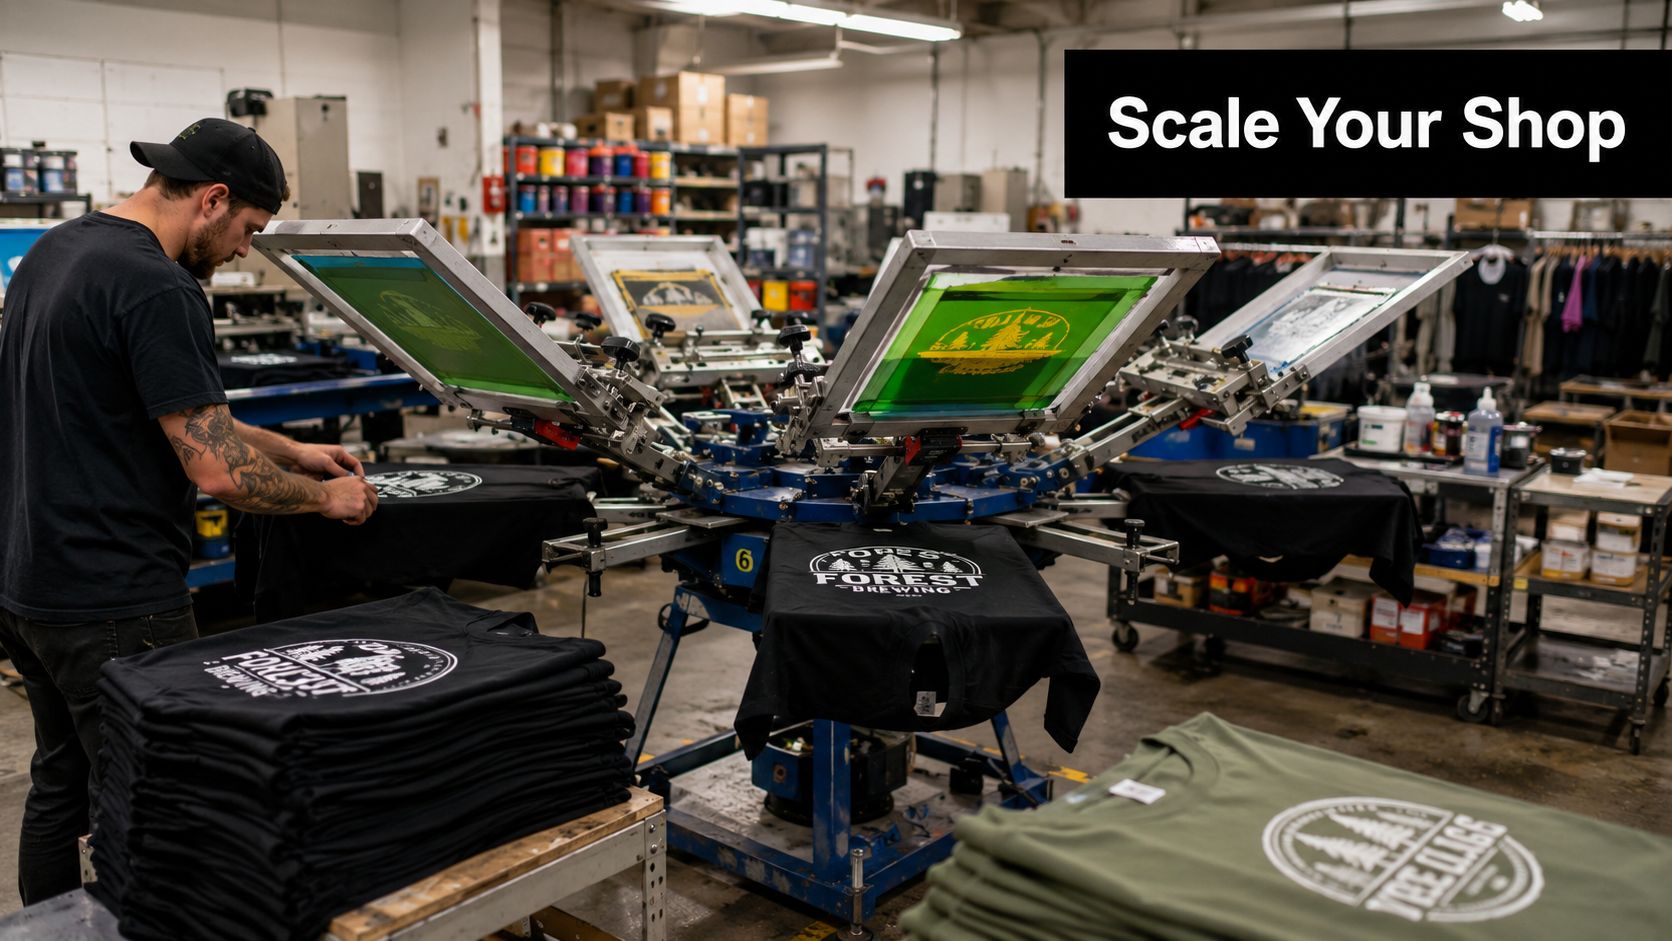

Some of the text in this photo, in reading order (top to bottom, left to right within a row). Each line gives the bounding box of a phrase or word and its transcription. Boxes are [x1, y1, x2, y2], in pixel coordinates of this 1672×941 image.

[735, 547, 754, 573] 6
[813, 573, 984, 588] FOREST
[852, 585, 951, 595] BREWING
